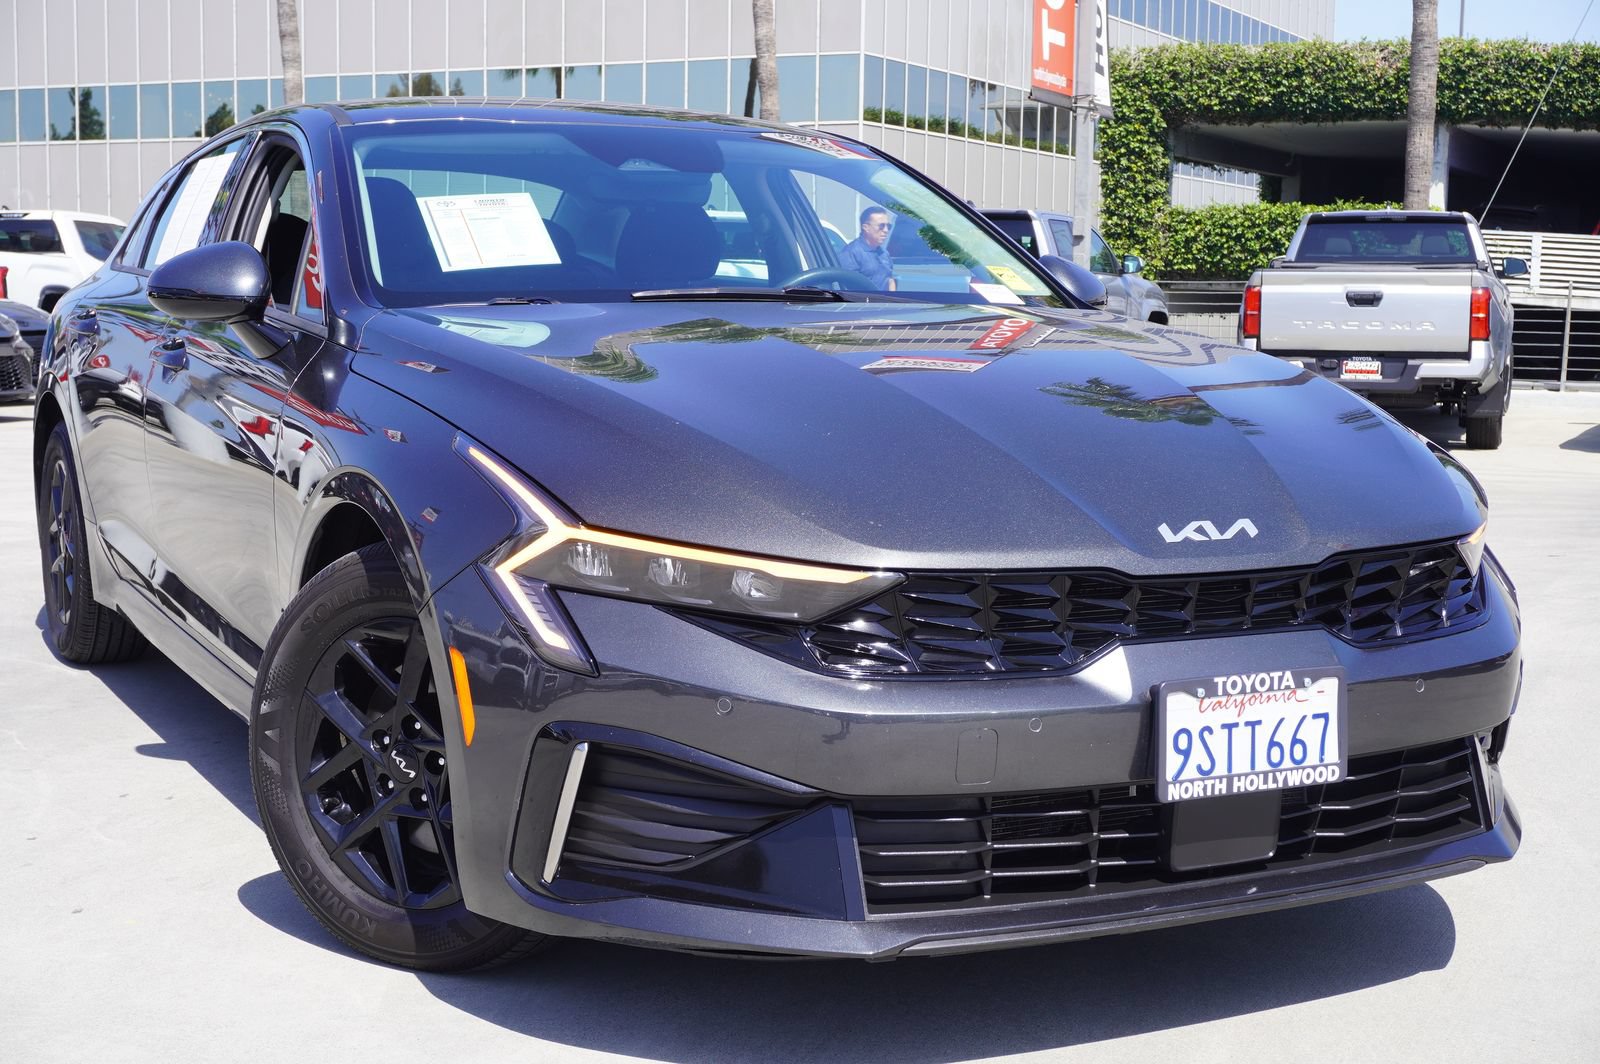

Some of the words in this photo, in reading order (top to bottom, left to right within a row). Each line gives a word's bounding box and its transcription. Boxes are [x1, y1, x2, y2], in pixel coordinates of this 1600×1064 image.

[1042, 0, 1066, 61] T
[1291, 320, 1436, 332] TACOMA
[1213, 671, 1295, 695] TOYOTA
[1198, 688, 1309, 717] California
[1172, 711, 1329, 781] 9STT667
[1167, 779, 1227, 801] NORTH
[1233, 765, 1340, 793] HOLLYWOOD
[295, 857, 378, 938] KUMHO
